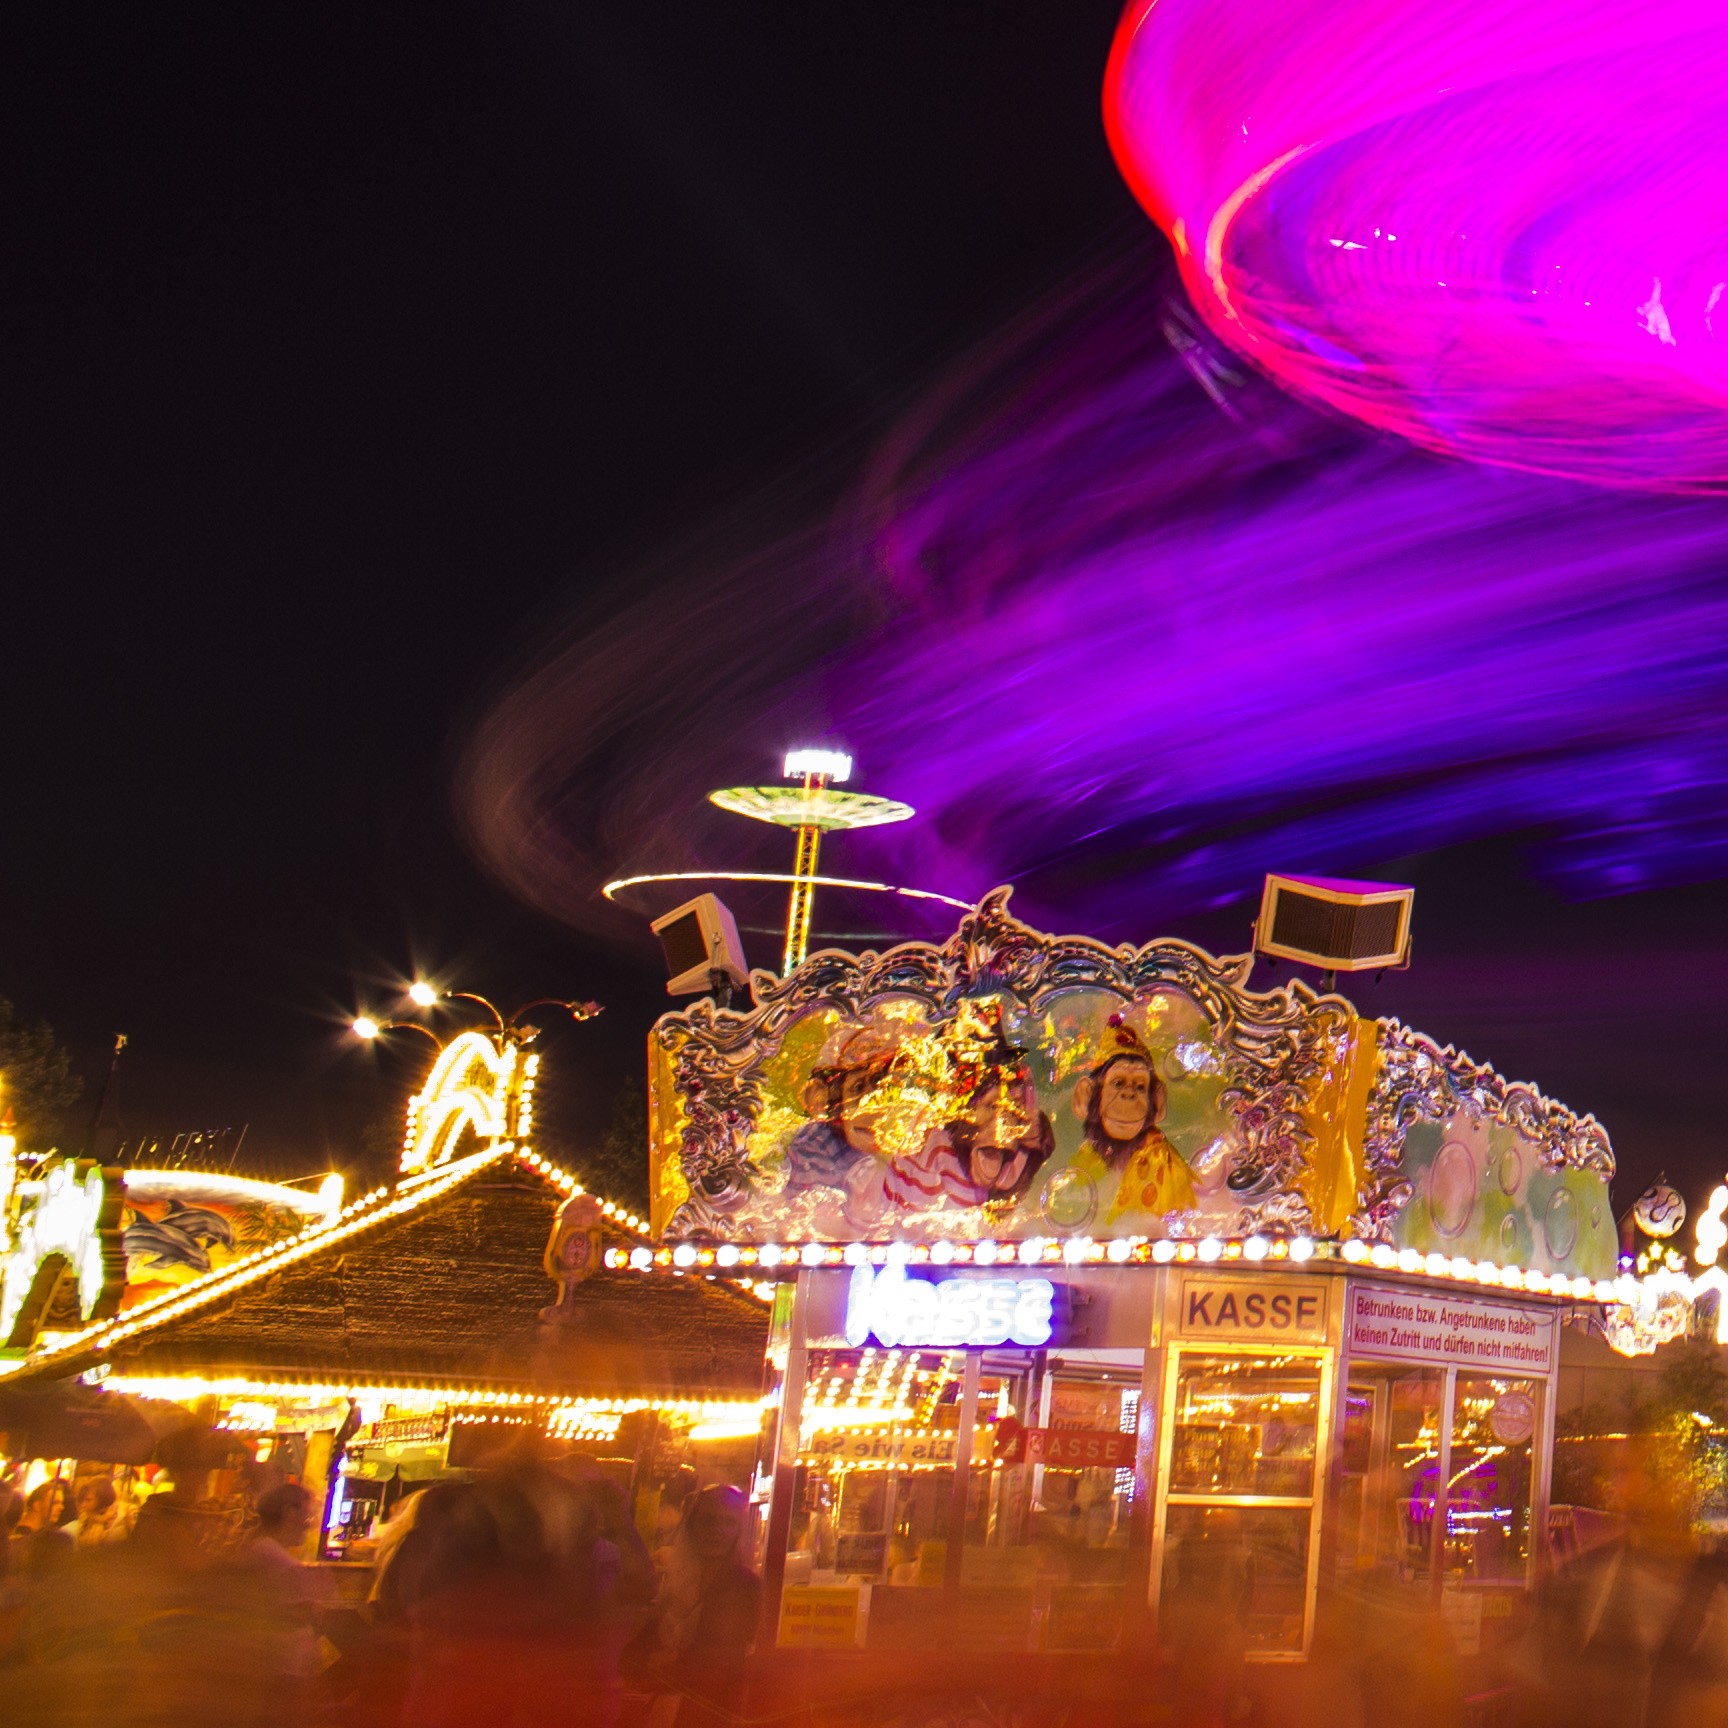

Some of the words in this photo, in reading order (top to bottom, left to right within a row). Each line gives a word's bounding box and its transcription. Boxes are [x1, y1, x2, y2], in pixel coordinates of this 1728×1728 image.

[1187, 1290, 1318, 1331] KASSE
[1356, 1296, 1414, 1321] Betrunkene
[1416, 1304, 1438, 1324] bzw.
[1440, 1307, 1506, 1332] Angetrunkene
[1508, 1316, 1537, 1335] haben
[1354, 1324, 1388, 1346] keinen
[1390, 1328, 1421, 1348] Zutritt
[1423, 1334, 1442, 1351] und
[1444, 1335, 1475, 1355] dürfen
[1477, 1338, 1501, 1358] nicht
[1502, 1342, 1549, 1362] mitfahren!
